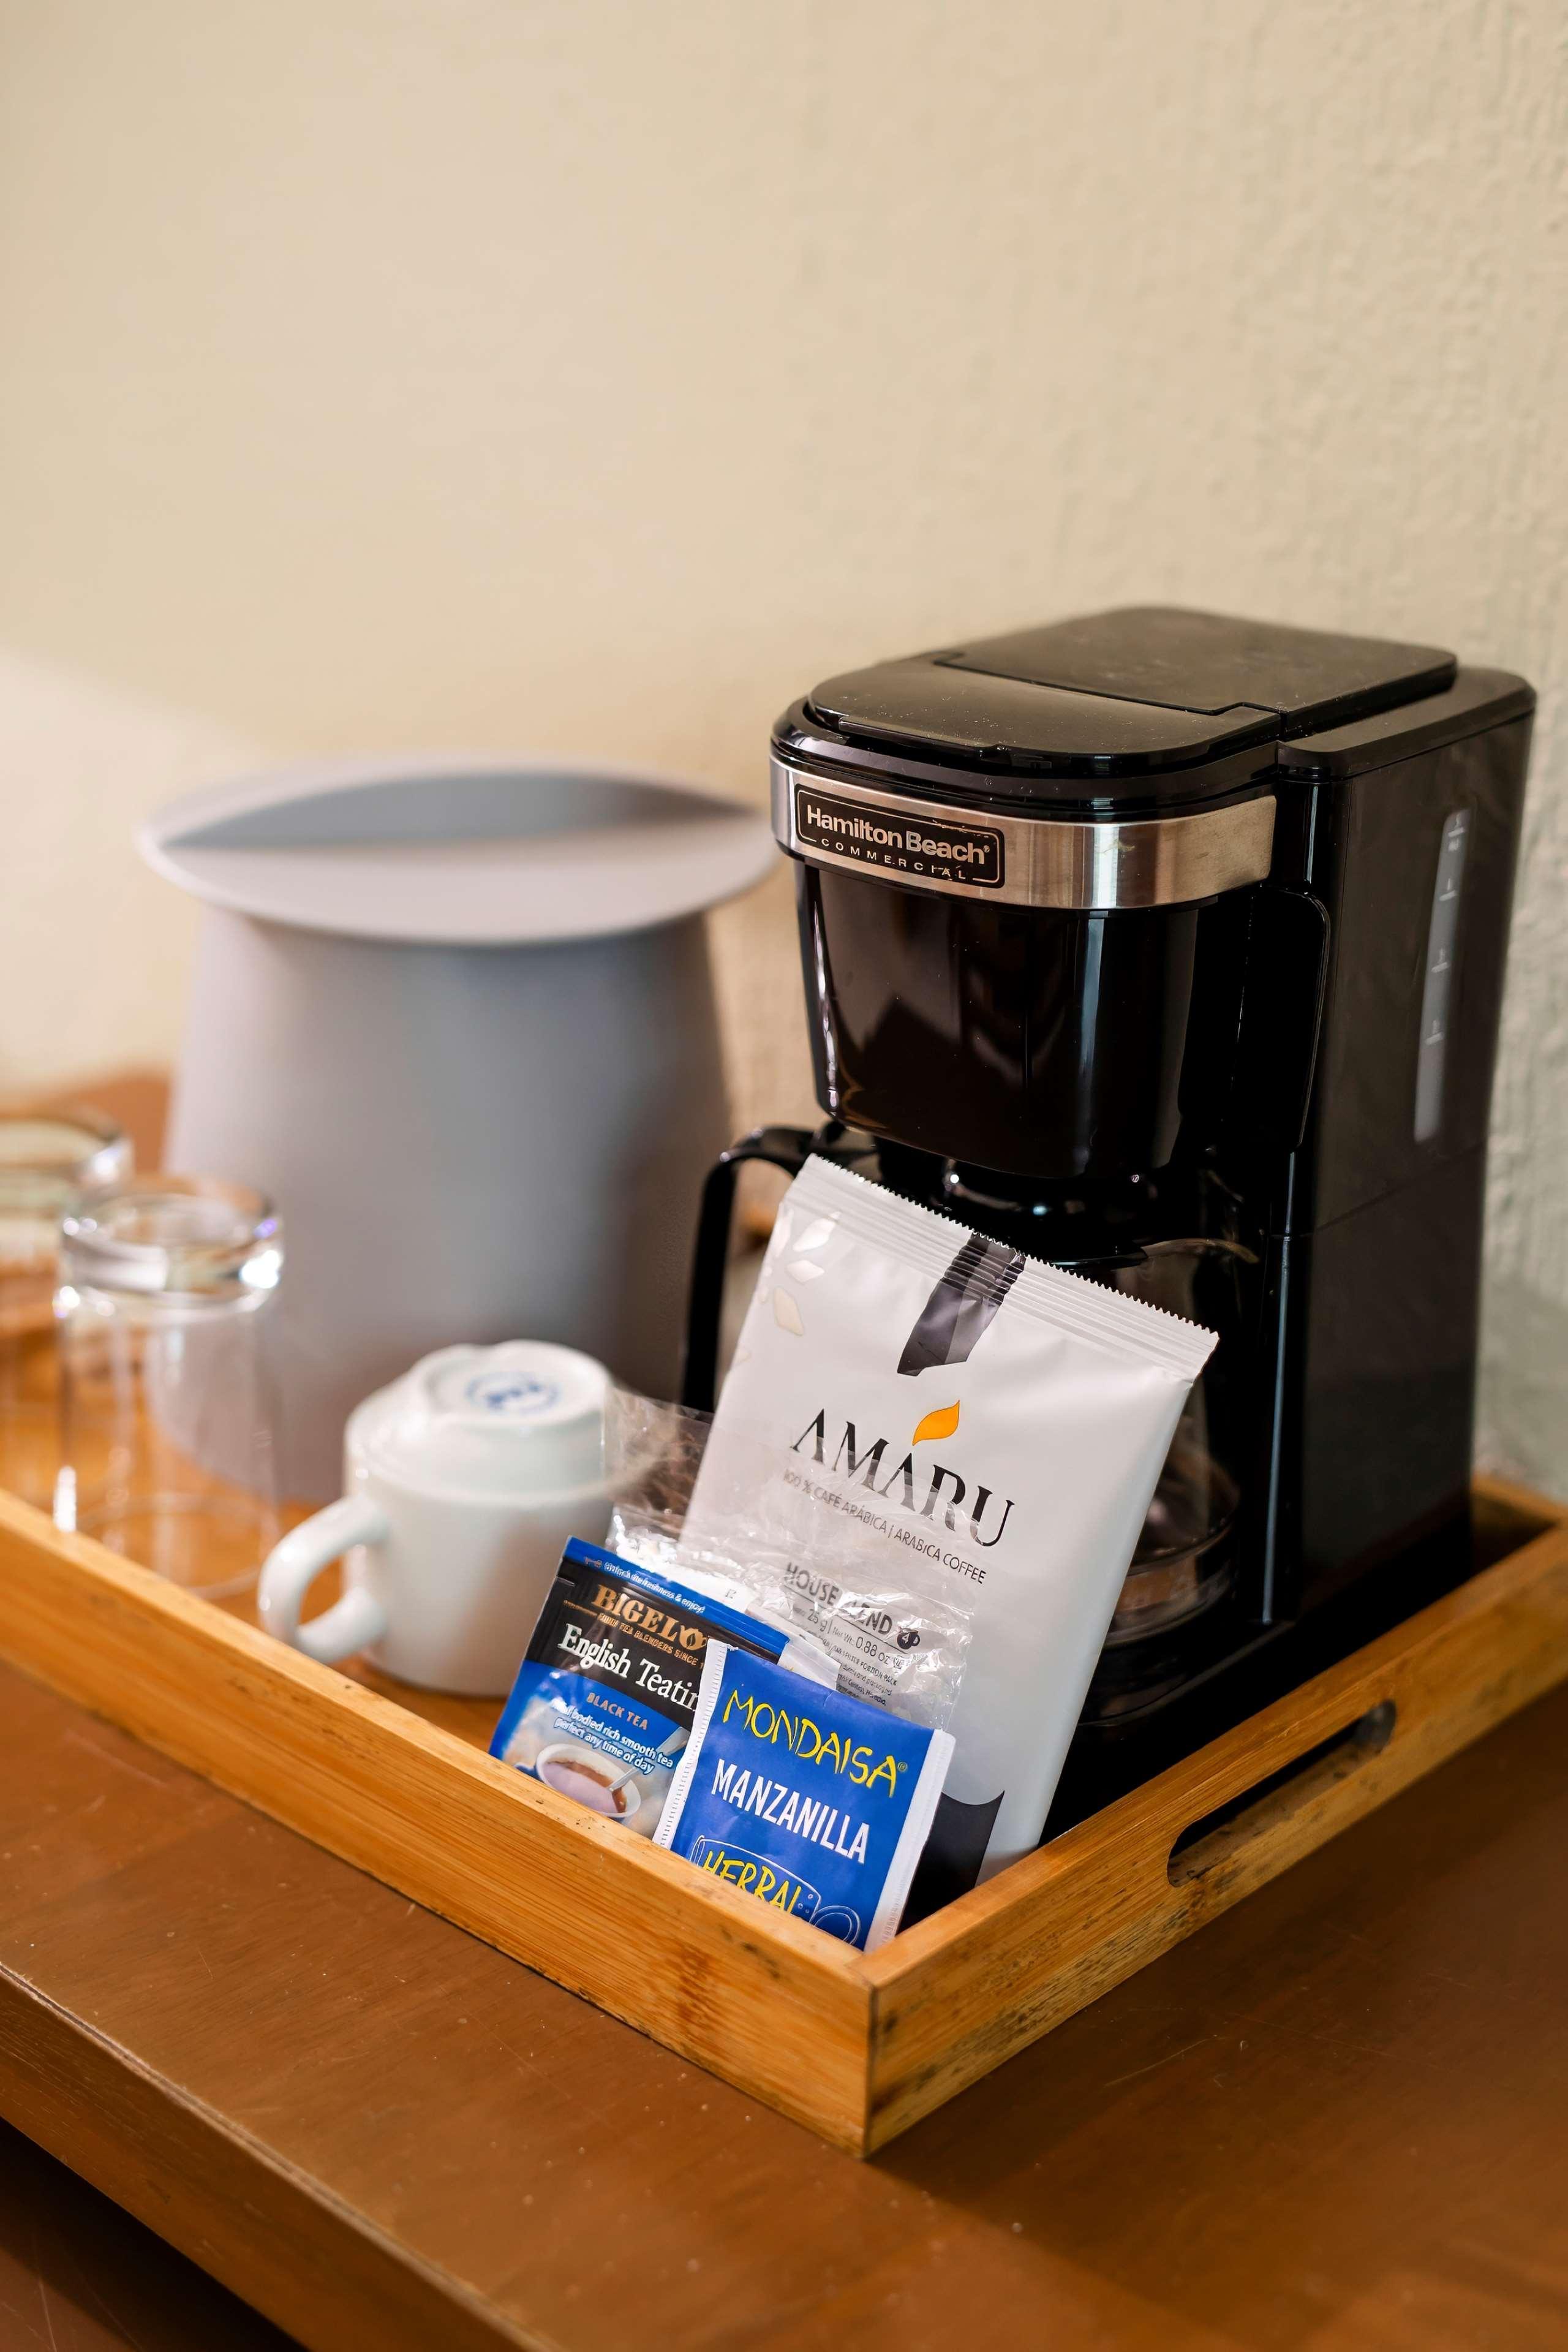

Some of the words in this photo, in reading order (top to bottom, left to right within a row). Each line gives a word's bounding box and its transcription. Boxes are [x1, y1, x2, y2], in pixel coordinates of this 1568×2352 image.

[807, 804, 903, 849] Hamilton
[821, 838, 966, 880] COMMERCIAL
[790, 1408, 1015, 1547] AMARU
[894, 1528, 941, 1562] ARABICA
[943, 1554, 986, 1585] COFFEE
[782, 1563, 839, 1606] HOUSE
[591, 1584, 707, 1651] BIGELO
[806, 1609, 820, 1622] 25
[820, 1620, 828, 1632] g
[854, 1637, 878, 1656] 0.88
[557, 1622, 630, 1678] English
[674, 1651, 697, 1665] SINCE
[586, 1692, 624, 1719] BLACK
[627, 1712, 648, 1730] TEA
[584, 1734, 601, 1749] any
[602, 1741, 623, 1756] time
[624, 1752, 635, 1762] of
[633, 1757, 654, 1774] day
[603, 1726, 620, 1739] rich
[620, 1736, 656, 1758] smooth
[657, 1753, 674, 1767] tea
[711, 1759, 870, 1864] MANZANILLA
